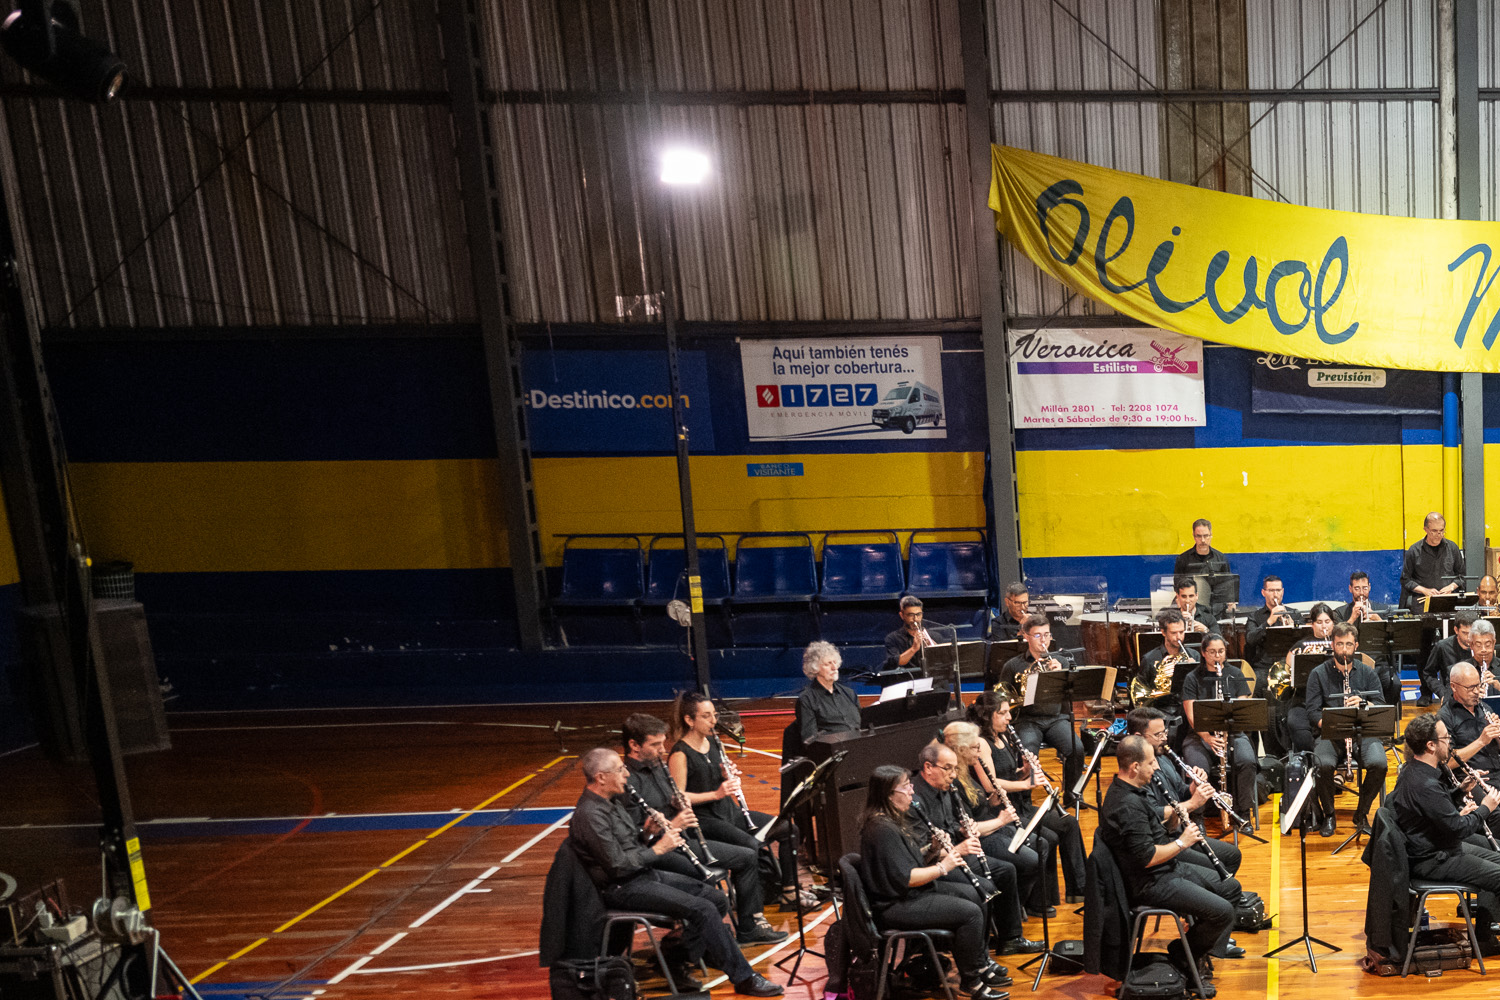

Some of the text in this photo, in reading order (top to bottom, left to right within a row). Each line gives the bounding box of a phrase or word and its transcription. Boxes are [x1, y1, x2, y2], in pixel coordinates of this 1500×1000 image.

[1035, 179, 1359, 345] Olivol
[773, 345, 909, 363] Aquí también tenés
[1012, 334, 1136, 360] Veronica
[773, 361, 915, 378] la mejor cobertura...
[1093, 363, 1138, 373] Estilista
[1316, 370, 1372, 382] Previsión
[1041, 404, 1069, 413] Millán
[1111, 404, 1126, 412] Tel:
[1128, 404, 1152, 412] 2208
[1156, 404, 1178, 412] 1074
[1023, 416, 1055, 424] Martes
[1066, 415, 1106, 424] Sábados
[1109, 415, 1120, 423] de
[1123, 415, 1143, 423] 9:30
[1155, 415, 1182, 423] 19:00
[1184, 414, 1197, 422] hs.
